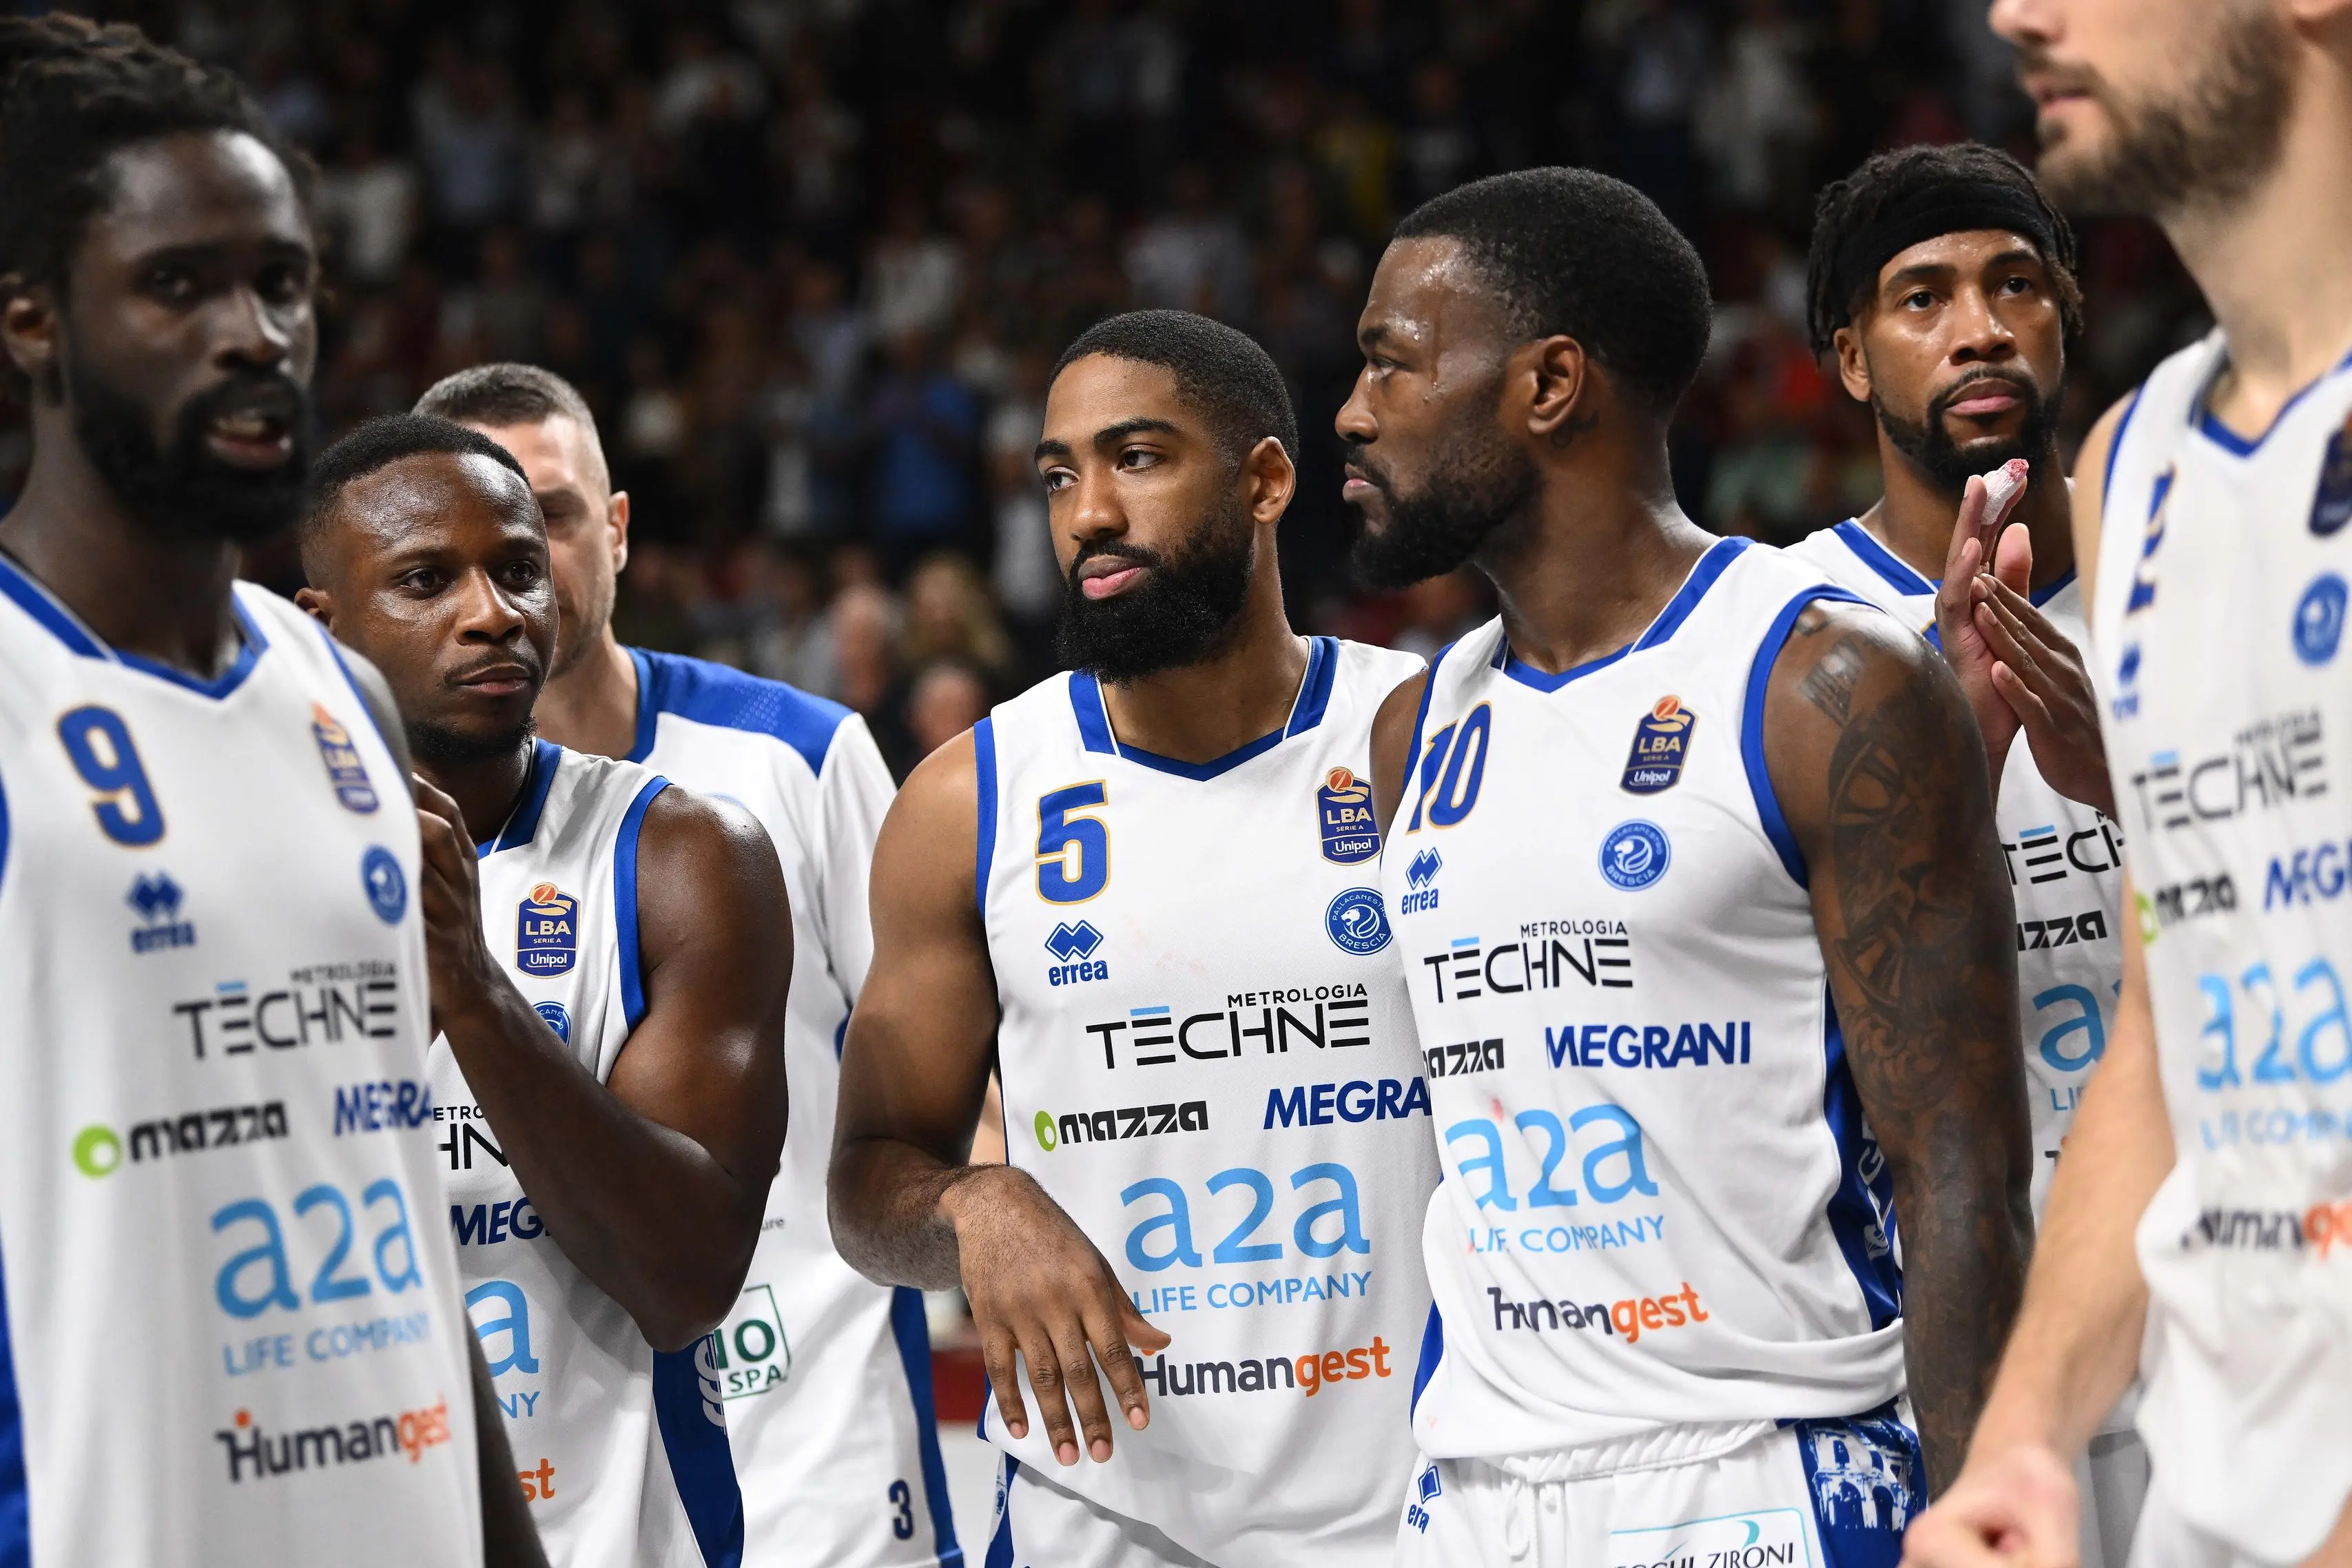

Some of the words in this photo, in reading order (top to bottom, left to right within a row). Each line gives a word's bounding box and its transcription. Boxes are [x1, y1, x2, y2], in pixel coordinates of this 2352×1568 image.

[1638, 736, 1681, 754] LBA
[56, 705, 167, 849] 9
[1405, 699, 1493, 836] 10
[1634, 770, 1671, 785] Unipol
[1326, 807, 1372, 825] LBA
[1035, 779, 1111, 906] 5
[1334, 838, 1372, 854] Unipol
[1401, 887, 1439, 915] errea
[525, 920, 571, 936] LBA
[1339, 932, 1387, 949] BRESCIA
[1520, 920, 1628, 938] METROLOGIA
[530, 953, 567, 967] Unipol
[1049, 959, 1109, 987] errea
[1227, 982, 1368, 1009] METROLOGIA
[1545, 1021, 1751, 1069] MEGRANI
[1059, 1100, 1209, 1146] mazza
[1444, 1104, 1660, 1213] a2a
[450, 1197, 550, 1246] MEG
[1120, 1162, 1371, 1272] a2a
[1520, 1215, 1664, 1253] COMPANY
[210, 1177, 423, 1319] a2a
[1133, 1286, 1197, 1316] LIFE
[1207, 1270, 1372, 1309] COMPANY
[223, 1332, 293, 1376] LIFE
[1133, 1336, 1392, 1398] Humangest
[728, 1365, 782, 1392] SPA
[889, 1478, 913, 1540] 3
